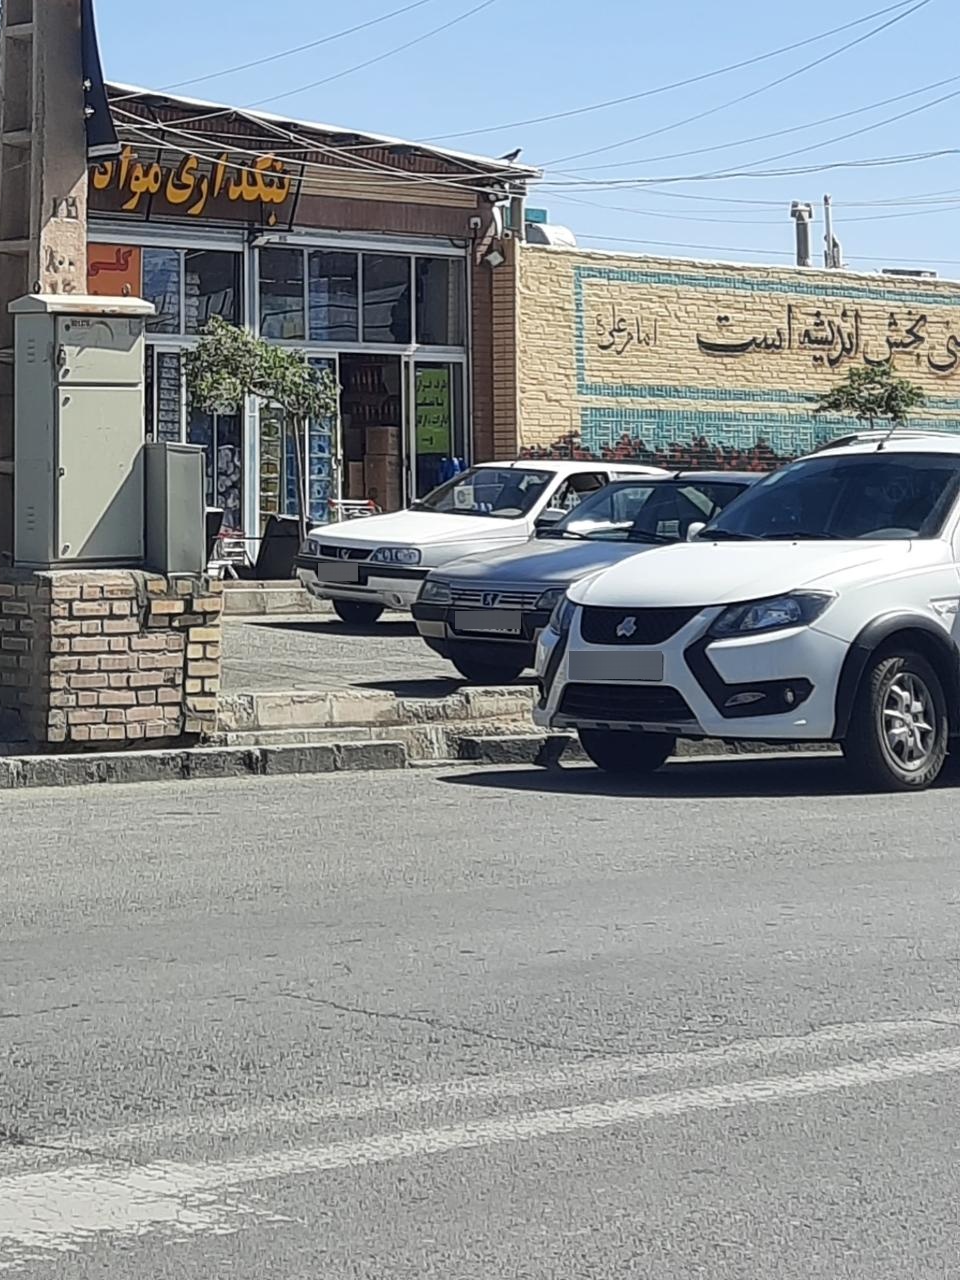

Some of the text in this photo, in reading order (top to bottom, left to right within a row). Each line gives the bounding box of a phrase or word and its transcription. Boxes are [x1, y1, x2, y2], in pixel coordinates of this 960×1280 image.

[93, 145, 161, 210] مواد
[597, 303, 628, 350] علی
[615, 316, 658, 355] امام
[696, 303, 792, 353] است
[799, 308, 860, 367] اندیشه
[863, 309, 927, 367] بخش
